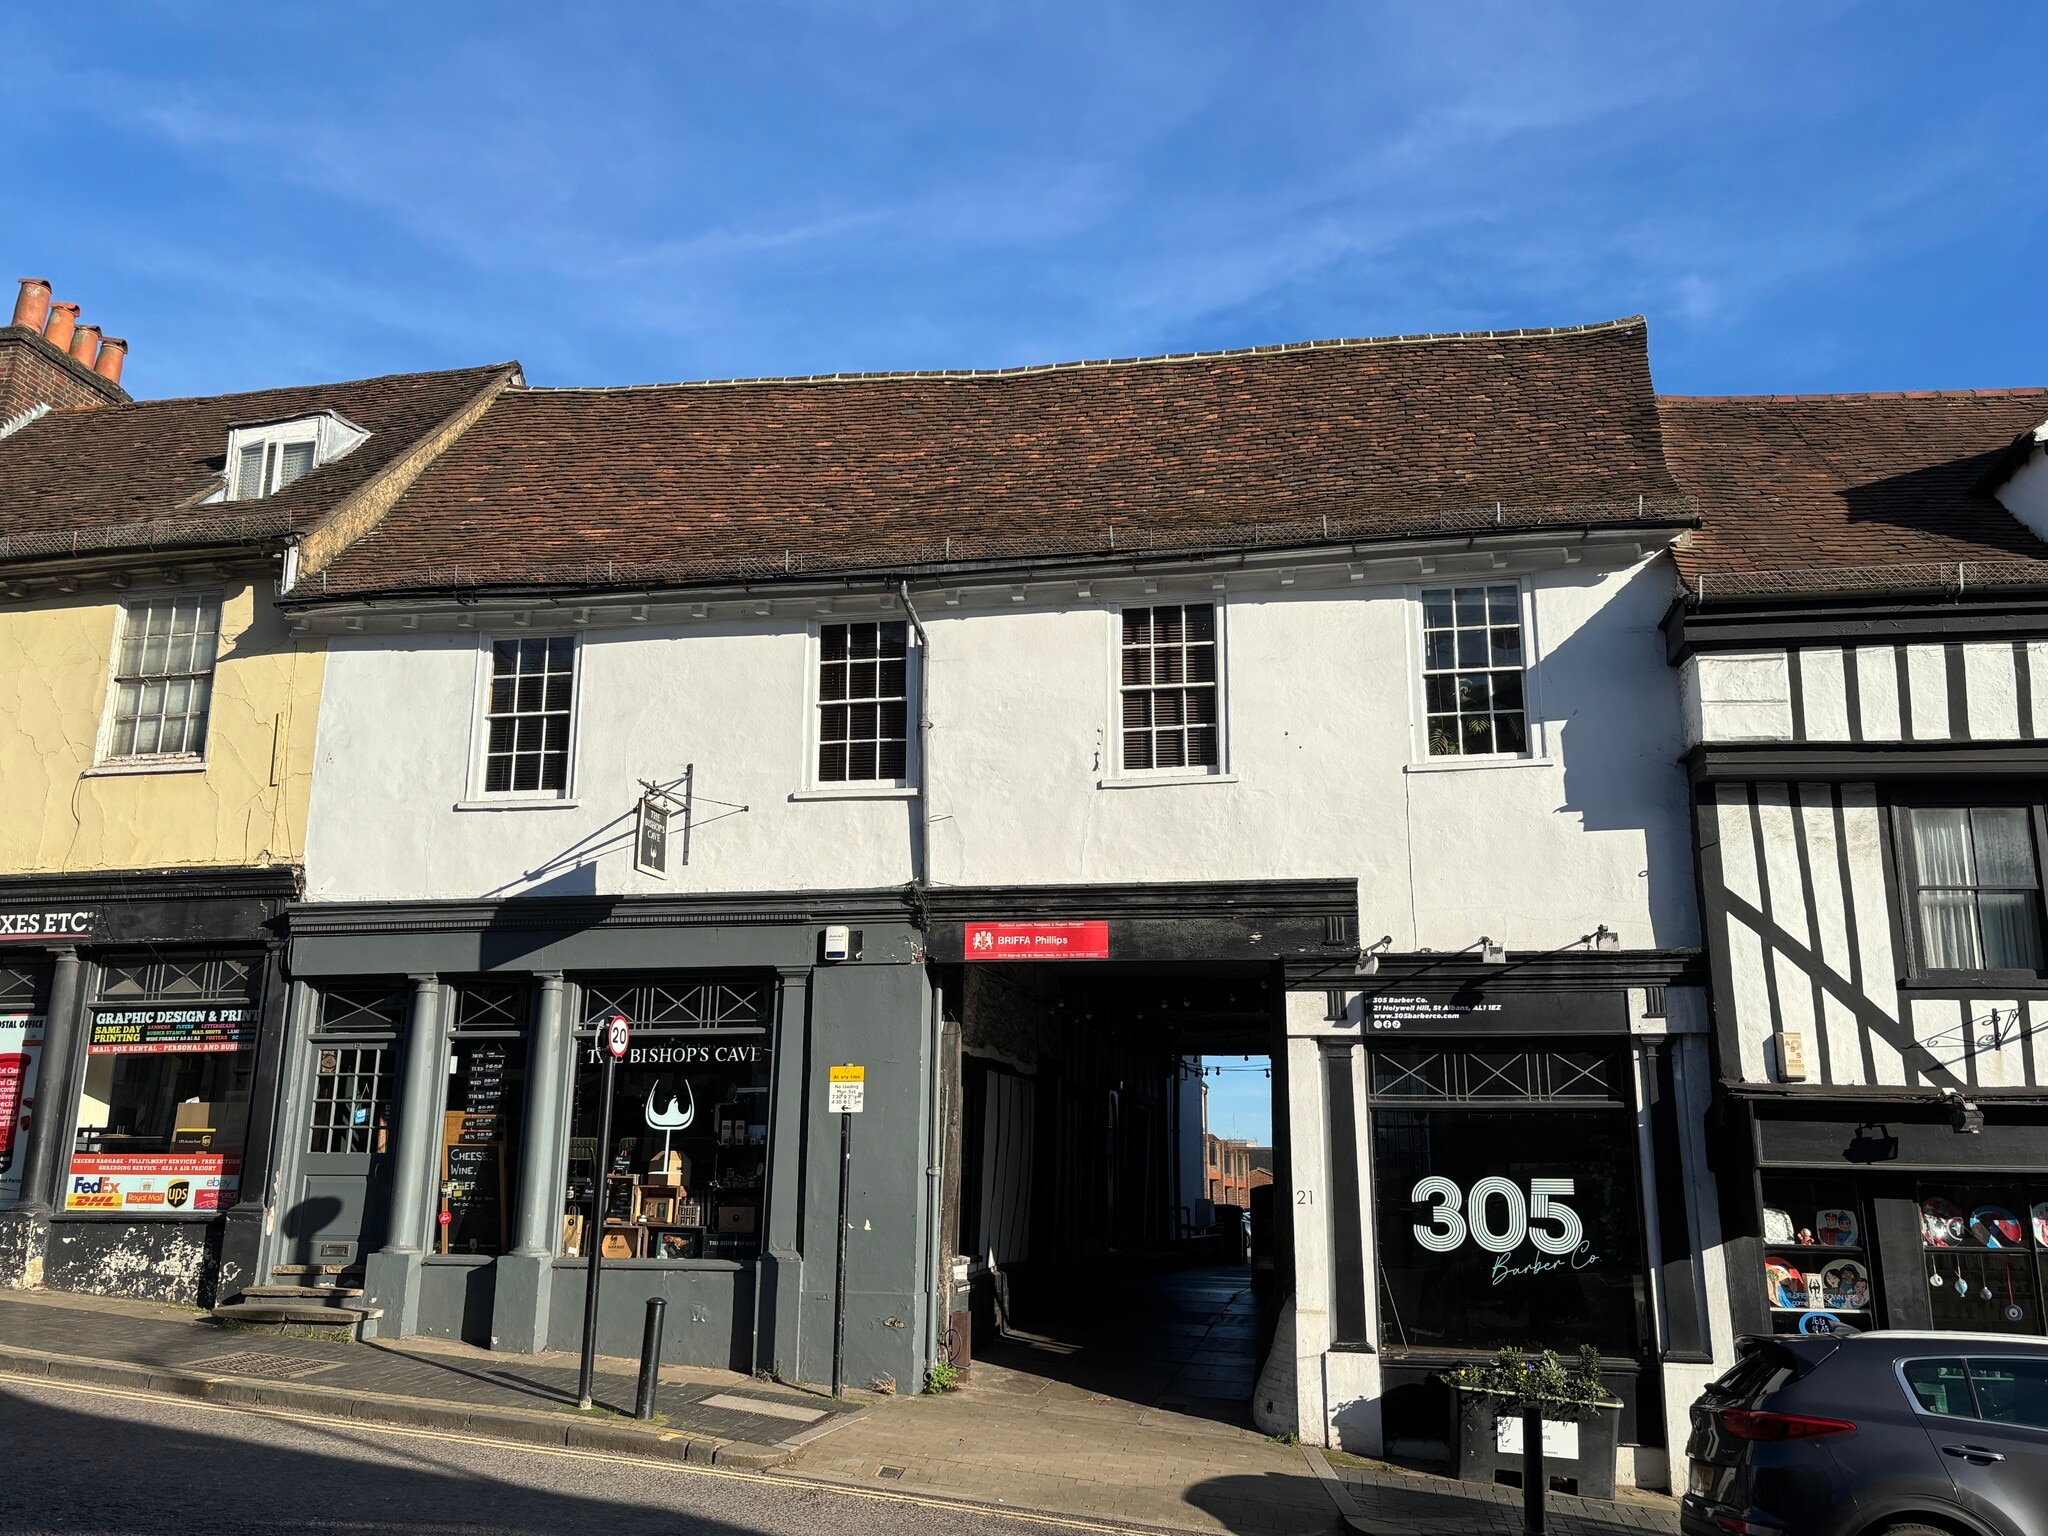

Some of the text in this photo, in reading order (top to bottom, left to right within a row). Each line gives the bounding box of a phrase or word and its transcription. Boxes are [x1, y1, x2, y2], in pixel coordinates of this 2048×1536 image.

[651, 810, 660, 822] THE
[647, 830, 660, 842] CAVE
[0, 913, 40, 934] XES
[998, 936, 1068, 946] BRIFFA Phillips
[1382, 1004, 1416, 1012] Holywell
[1416, 1004, 1432, 1012] Hill,
[1442, 1004, 1471, 1012] Albans,
[96, 1011, 155, 1024] GRAPHIC
[156, 1010, 206, 1023] DESIGN
[208, 1010, 217, 1022] &
[0, 1020, 44, 1028] STAL OFFICE
[95, 1026, 122, 1034] SAME
[94, 1034, 140, 1042] PRINTING
[612, 1027, 626, 1044] 20
[164, 1044, 202, 1052] PERSONAL
[630, 1047, 709, 1064] BISHOP'S
[715, 1046, 762, 1062] CAVE
[450, 1164, 477, 1175] WINE.
[74, 1176, 120, 1194] FedEx
[206, 1176, 232, 1188] ebay
[74, 1196, 114, 1206] DHL
[128, 1194, 147, 1202] Royal
[168, 1188, 188, 1204] ups
[1296, 1190, 1312, 1204] 21
[1412, 1176, 1583, 1255] 305
[1492, 1250, 1565, 1286] Barber
